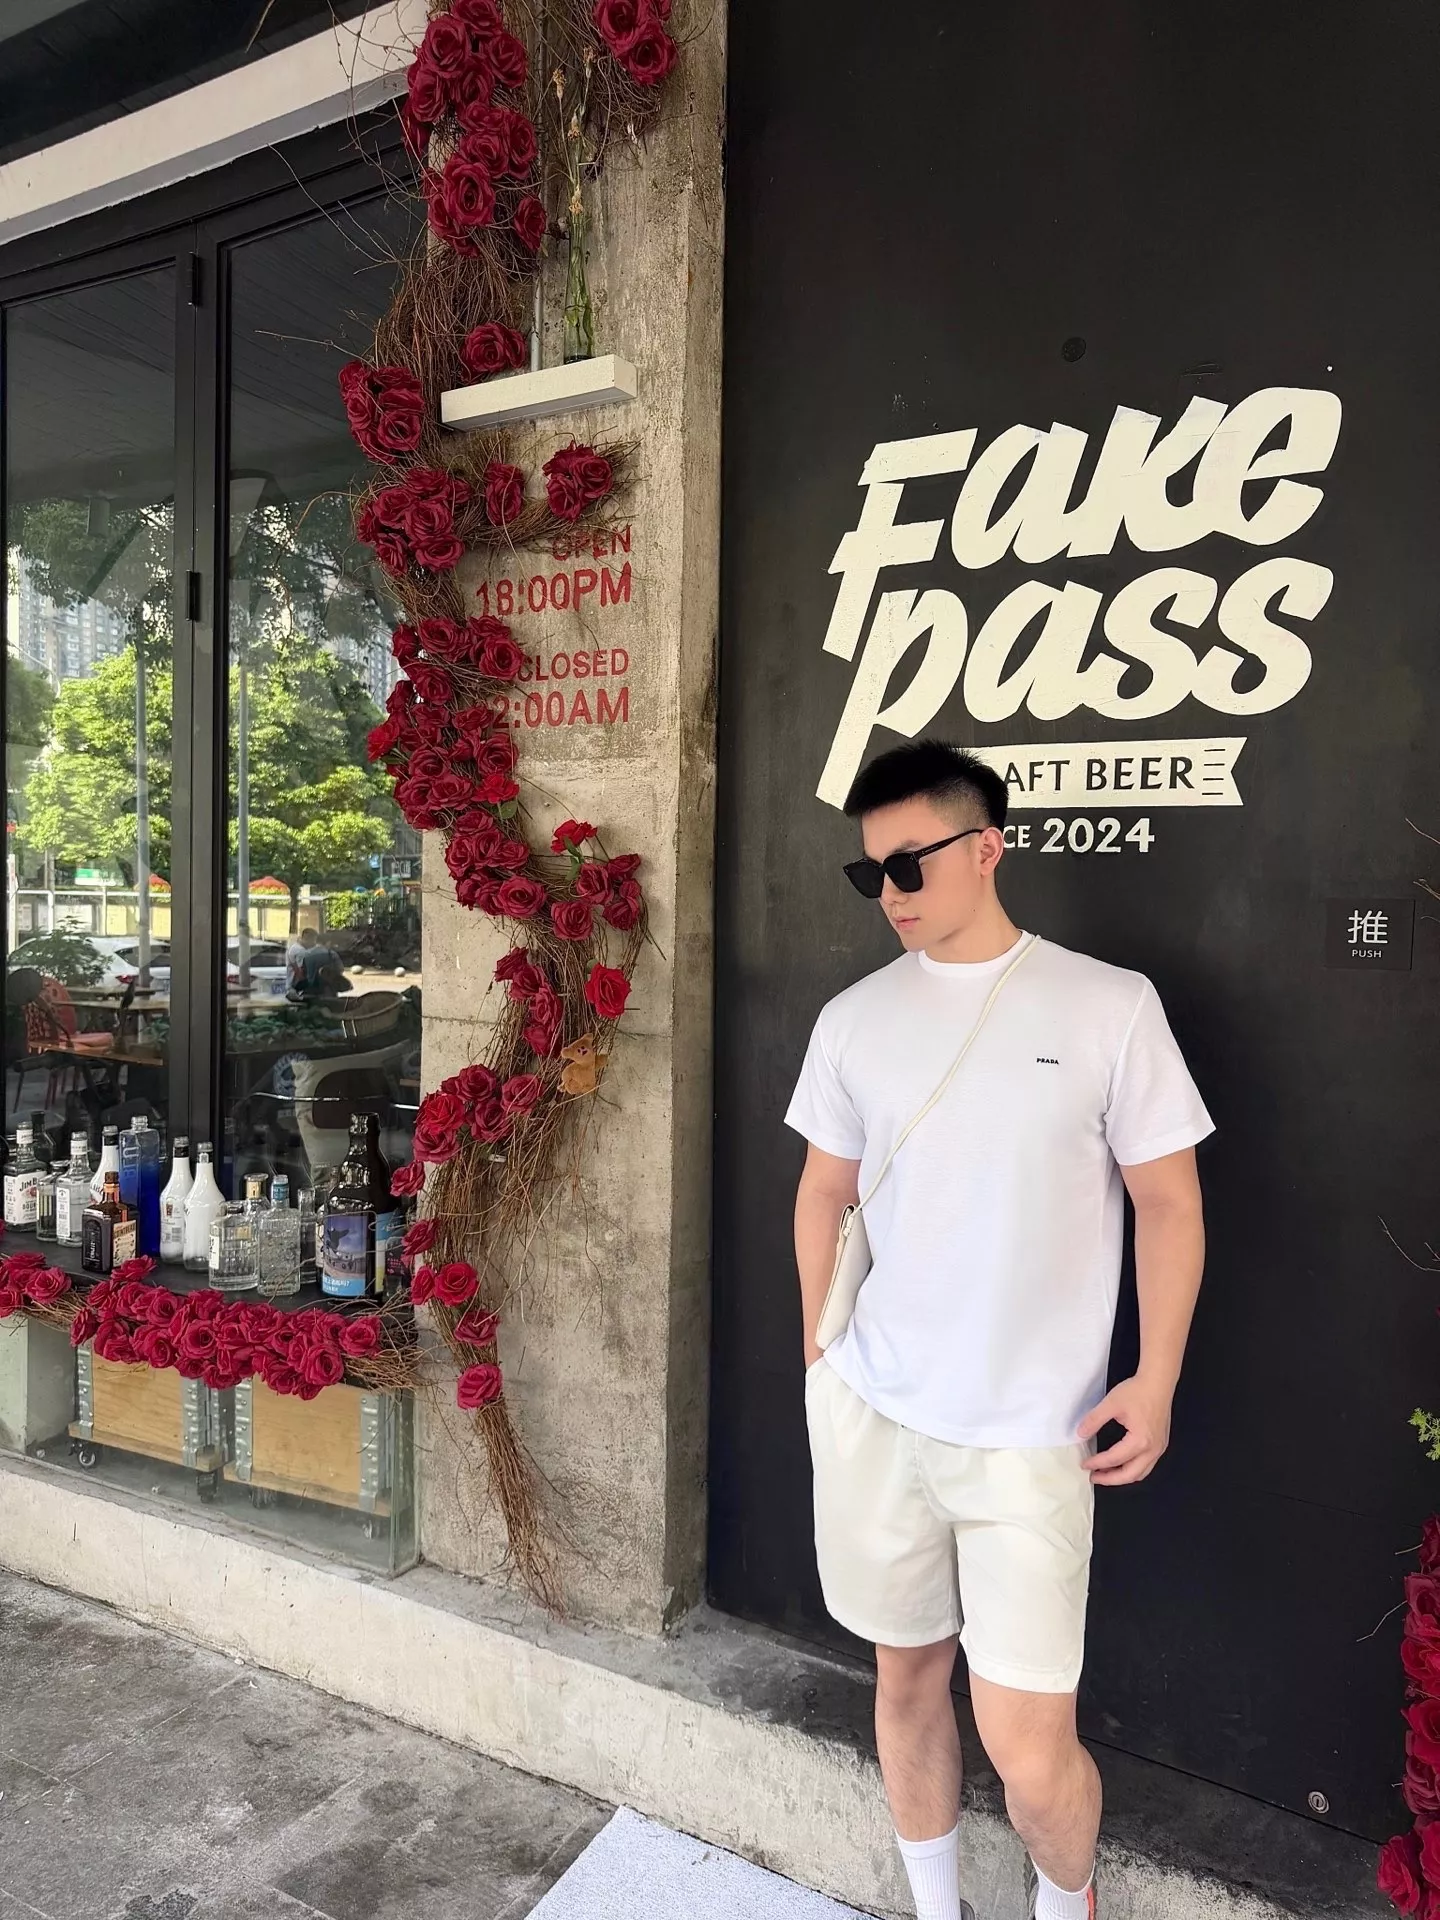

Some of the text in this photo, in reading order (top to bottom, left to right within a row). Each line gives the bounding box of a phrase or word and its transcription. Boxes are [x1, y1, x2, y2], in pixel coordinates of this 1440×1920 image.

[822, 387, 1342, 662] Fake
[476, 562, 632, 616] 18:00PM
[517, 648, 629, 682] CLOSED
[815, 557, 1334, 811] pass
[1003, 756, 1195, 792] AFT BEER
[1040, 818, 1155, 853] 2024
[1348, 910, 1388, 943] 推
[1352, 950, 1382, 958] PUSH
